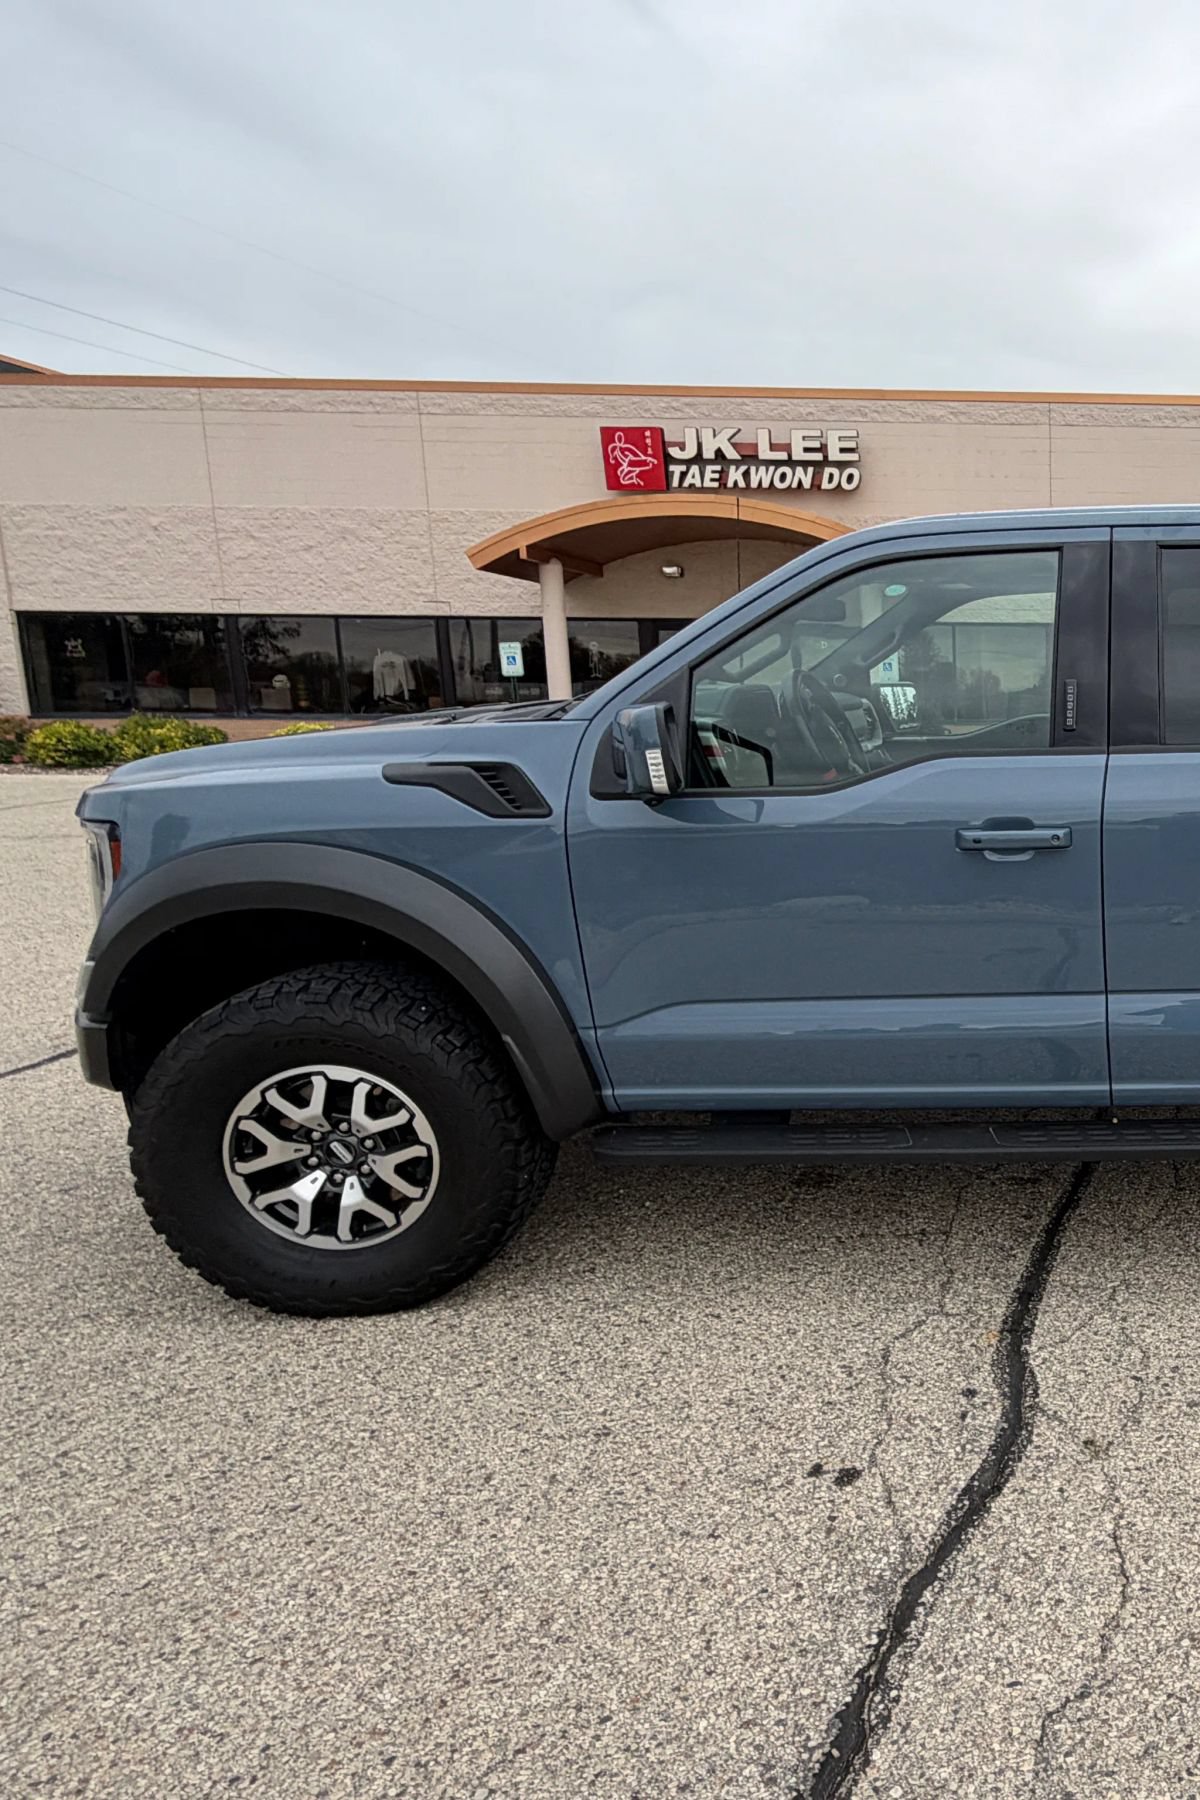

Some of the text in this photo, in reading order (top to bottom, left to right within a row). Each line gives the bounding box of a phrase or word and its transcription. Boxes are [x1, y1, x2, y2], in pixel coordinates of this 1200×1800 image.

[668, 427, 742, 460] JK
[757, 428, 861, 462] LEE
[669, 464, 861, 491] TAE KWON DO
